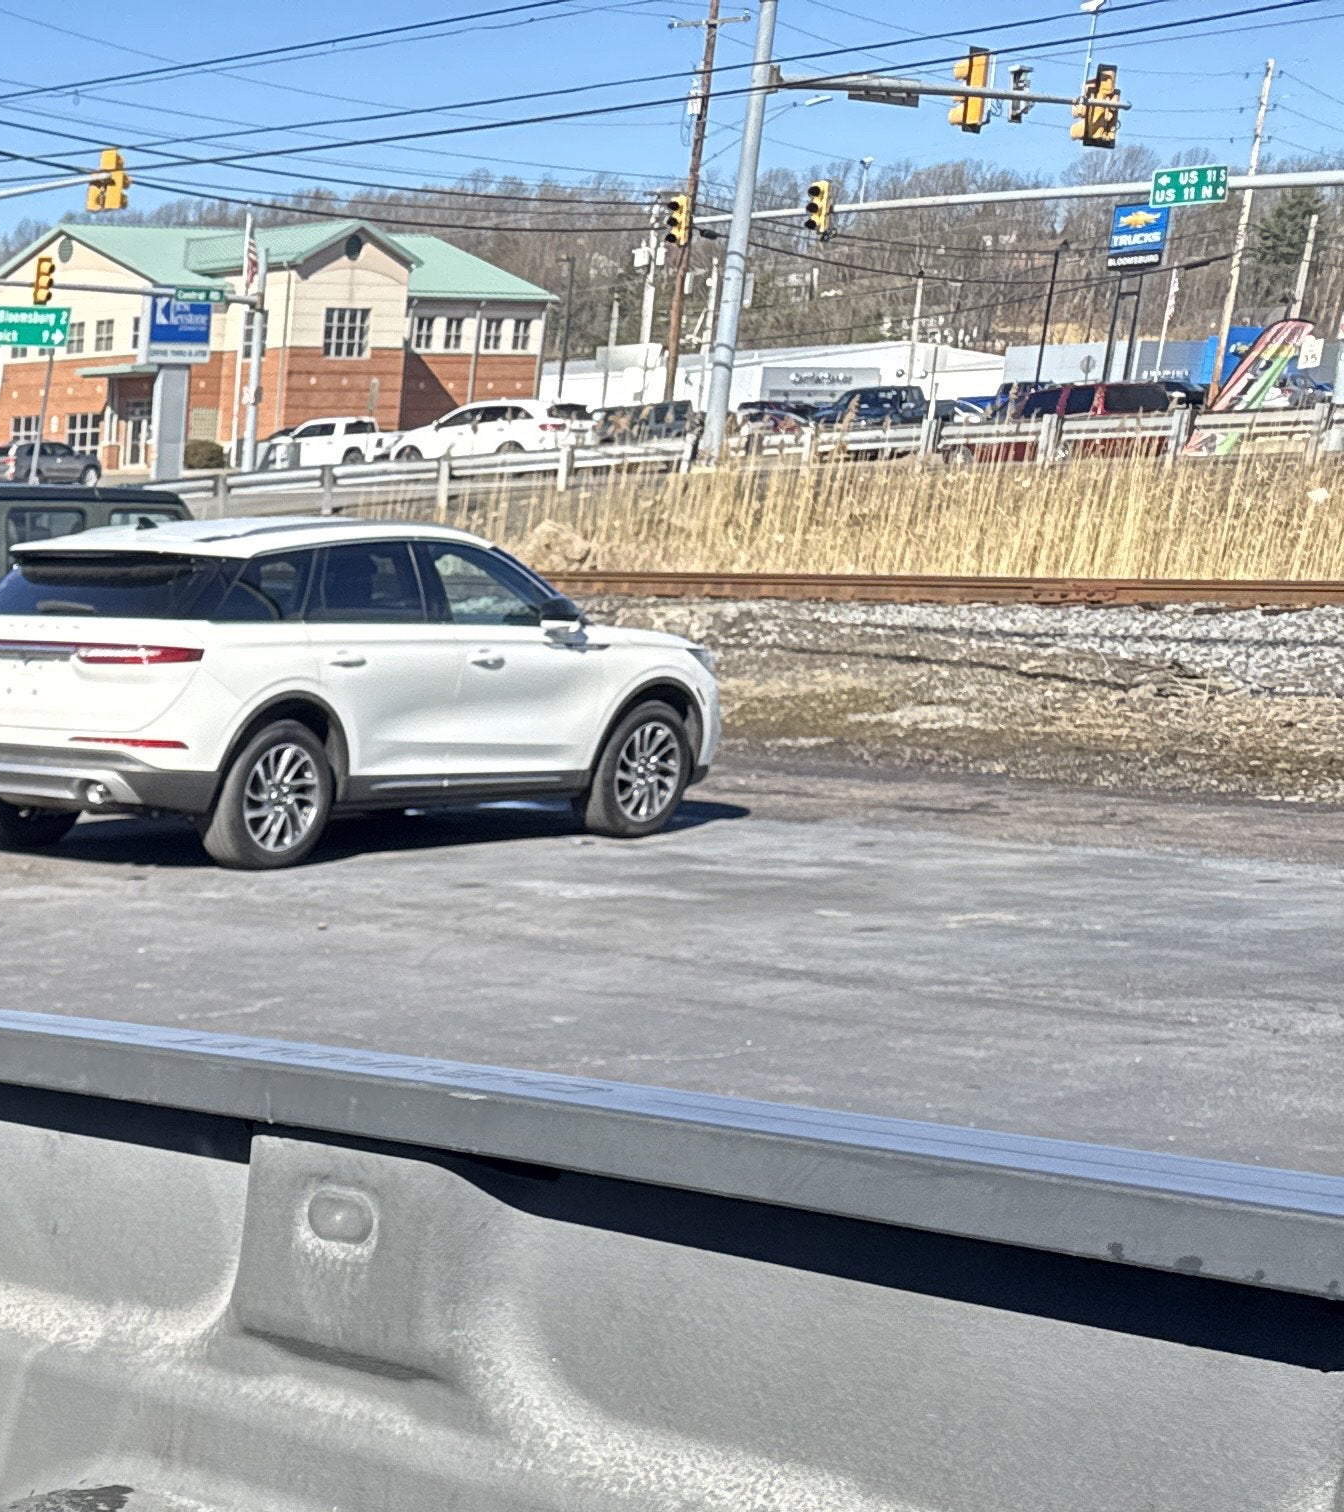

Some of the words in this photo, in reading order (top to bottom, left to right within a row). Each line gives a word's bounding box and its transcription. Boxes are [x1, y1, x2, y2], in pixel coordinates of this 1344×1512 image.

[1178, 171, 1198, 185] US
[1207, 169, 1217, 182] 11
[1219, 169, 1226, 182] S
[1155, 188, 1176, 203] US
[1183, 187, 1195, 200] 11
[1201, 185, 1213, 199] N
[1112, 231, 1161, 247] TRUCKS
[1107, 253, 1160, 268] BLOOMSBURG
[59, 310, 68, 325] 2
[41, 329, 50, 344] 9
